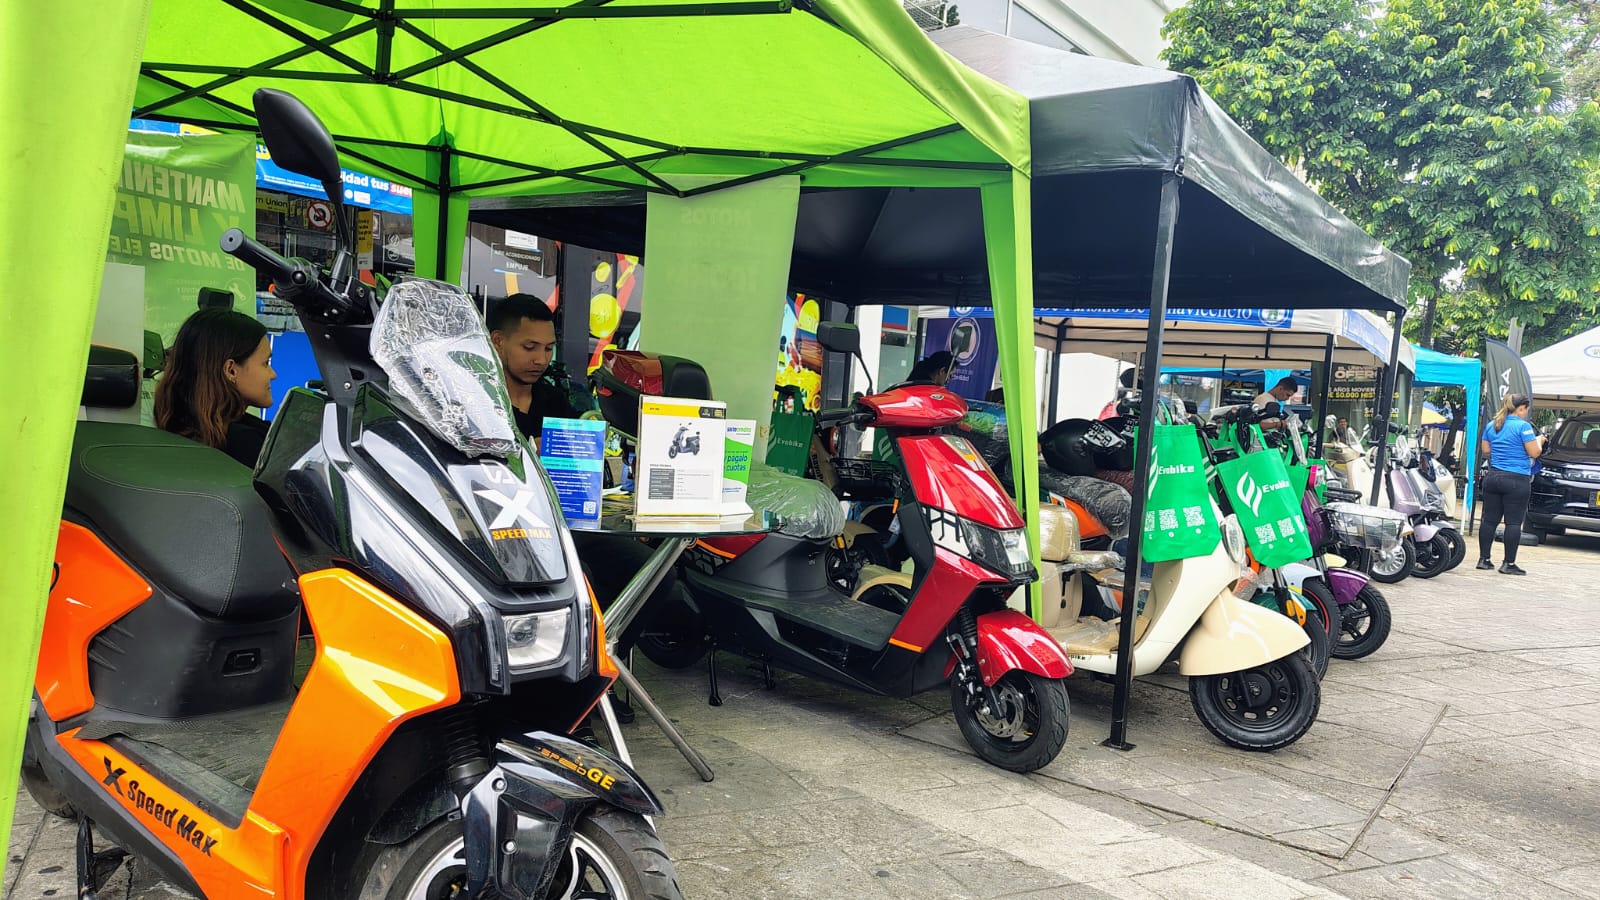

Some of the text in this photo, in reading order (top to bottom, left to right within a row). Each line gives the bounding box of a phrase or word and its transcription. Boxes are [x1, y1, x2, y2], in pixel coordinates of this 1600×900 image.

[370, 177, 389, 191] tus
[266, 197, 288, 208] Union
[491, 527, 553, 541] SPEED MAX
[103, 756, 218, 858] X Speed Max
